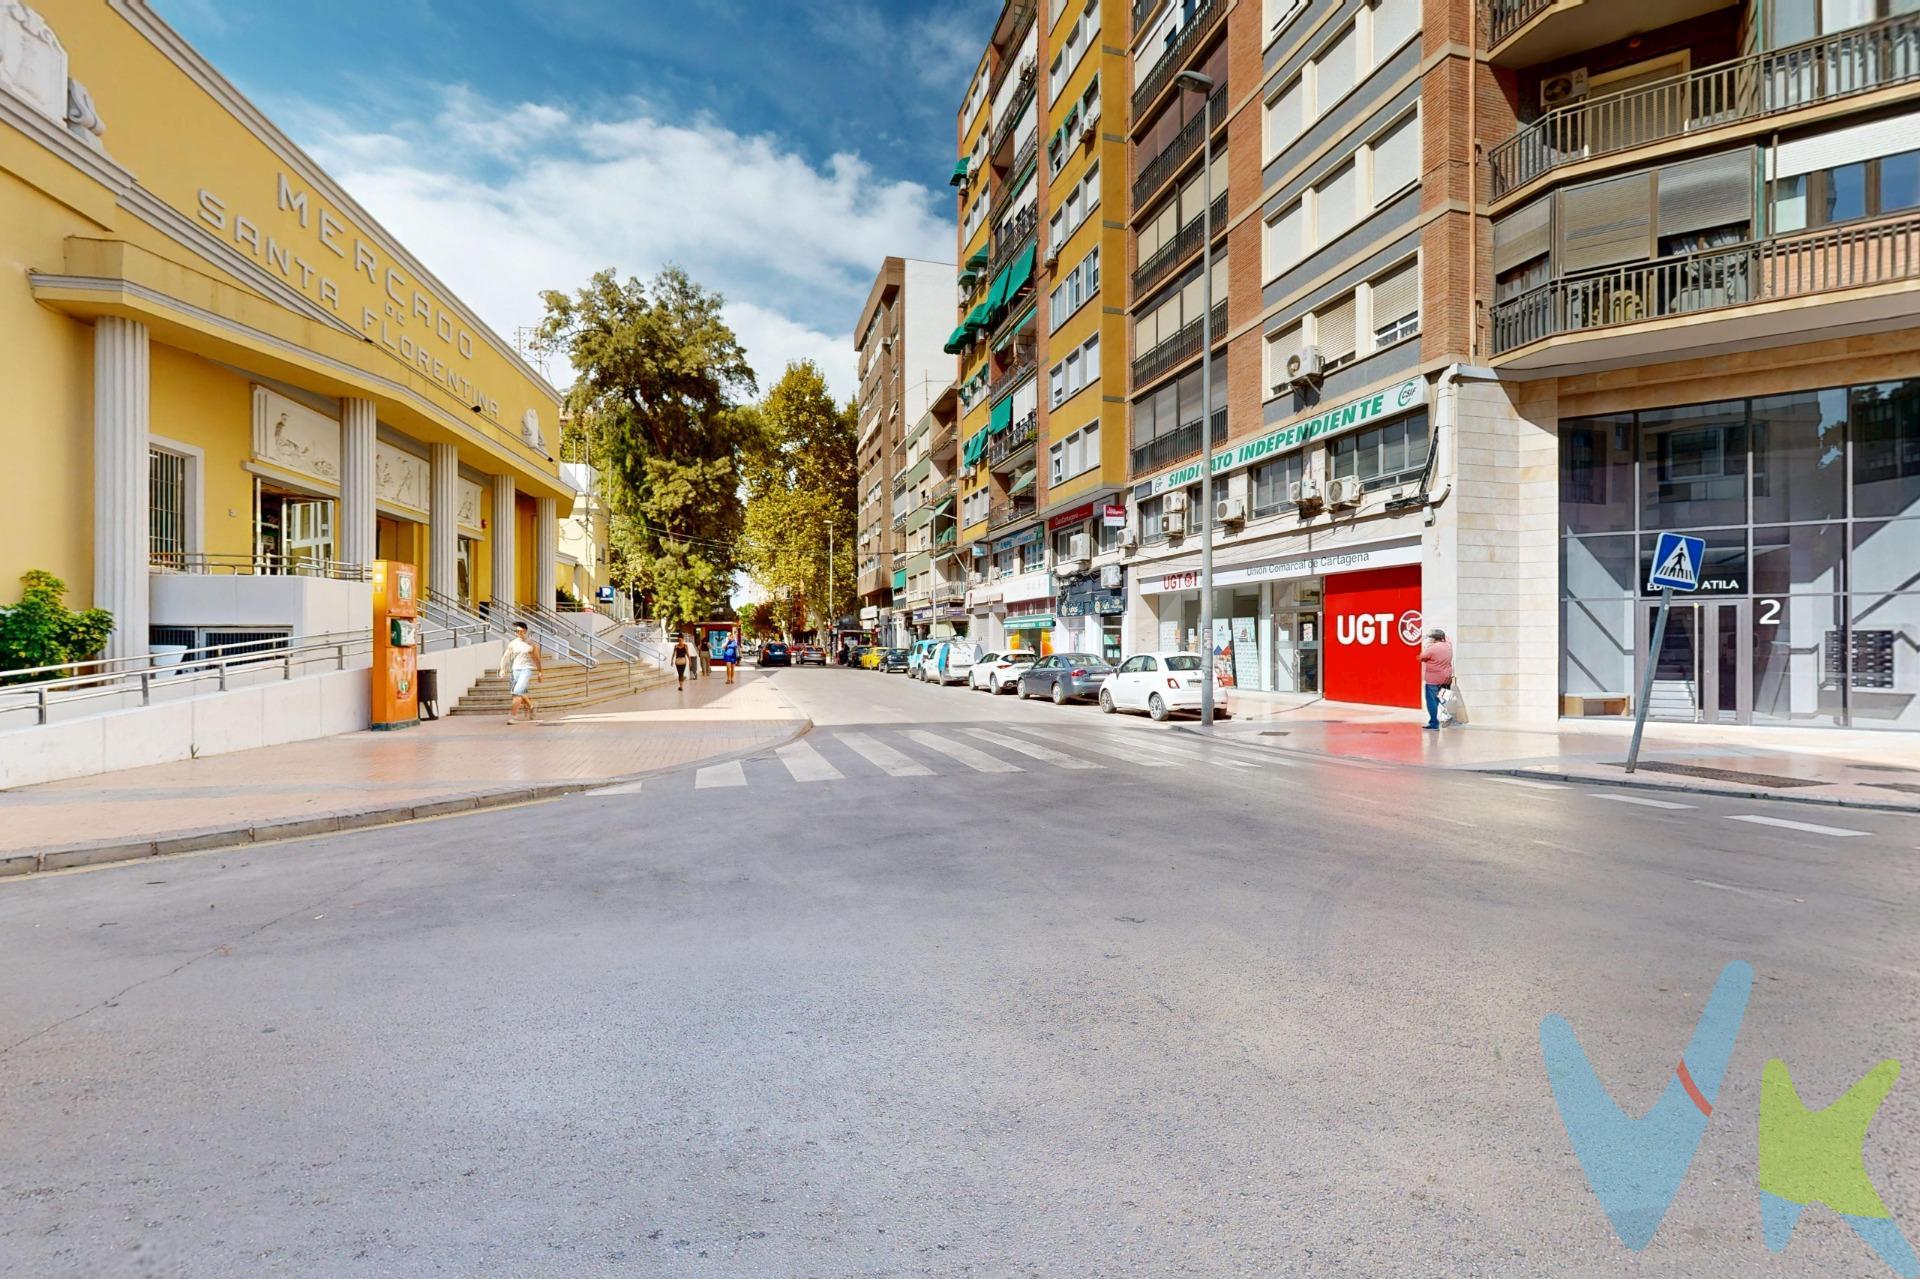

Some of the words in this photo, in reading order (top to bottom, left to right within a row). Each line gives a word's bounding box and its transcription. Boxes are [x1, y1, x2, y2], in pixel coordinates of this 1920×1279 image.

[278, 172, 472, 360] MERCADO
[198, 188, 340, 310] SANTA
[363, 306, 498, 418] FLORENTINA
[385, 303, 405, 326] DE
[1168, 452, 1233, 487] SINDIATO
[1238, 394, 1384, 463] INDEPENDIENTE
[1268, 559, 1306, 574] Comarcal
[1307, 559, 1319, 569] de
[1320, 552, 1370, 566] Cartagena
[602, 587, 611, 598] P
[1163, 573, 1183, 590] UGT
[1701, 580, 1740, 590] ATILA
[1759, 599, 1782, 625] 2
[1337, 613, 1395, 646] UGT
